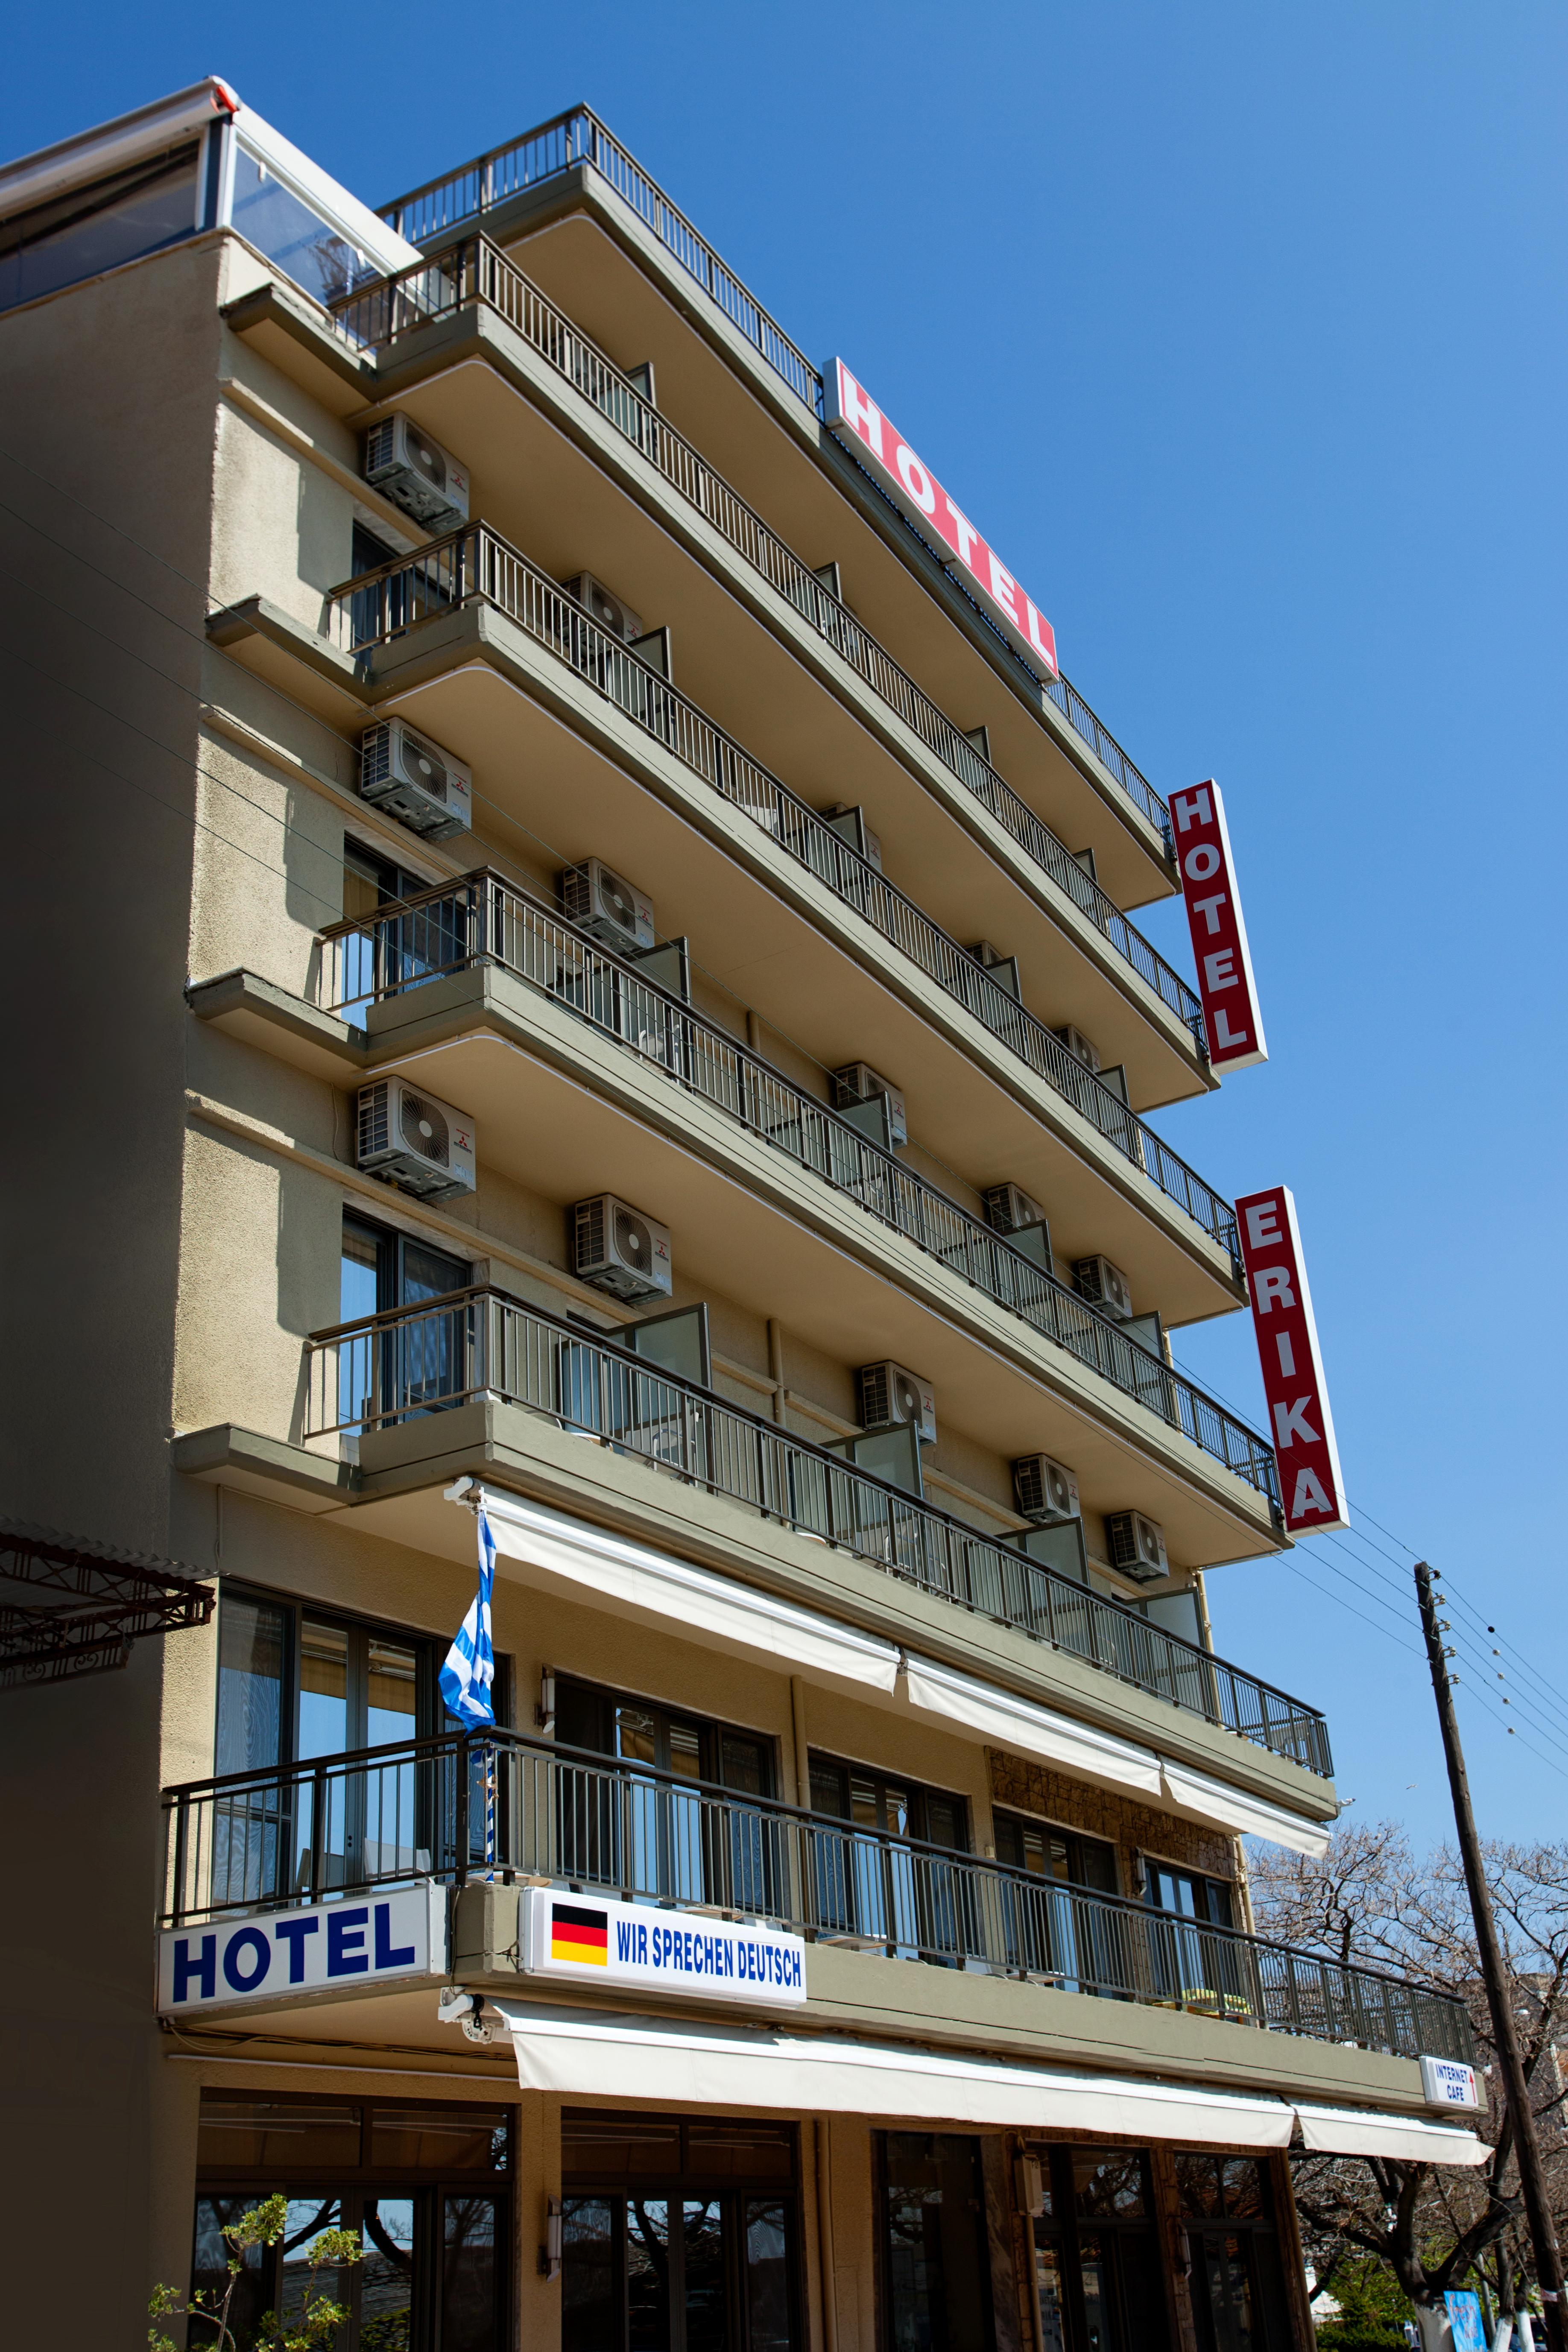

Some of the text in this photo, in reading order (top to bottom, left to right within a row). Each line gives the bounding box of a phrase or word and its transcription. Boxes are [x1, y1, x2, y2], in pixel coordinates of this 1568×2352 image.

[843, 369, 1053, 669] HOTEL
[1174, 788, 1247, 1049] HOTEL
[1245, 1200, 1333, 1519] ERIKA
[173, 1903, 415, 2003] HOTEL
[617, 1921, 801, 1987] WIR SPRECHEN DEUTSCH
[1436, 2064, 1468, 2083] INTERNET
[1447, 2085, 1464, 2101] CAFE
